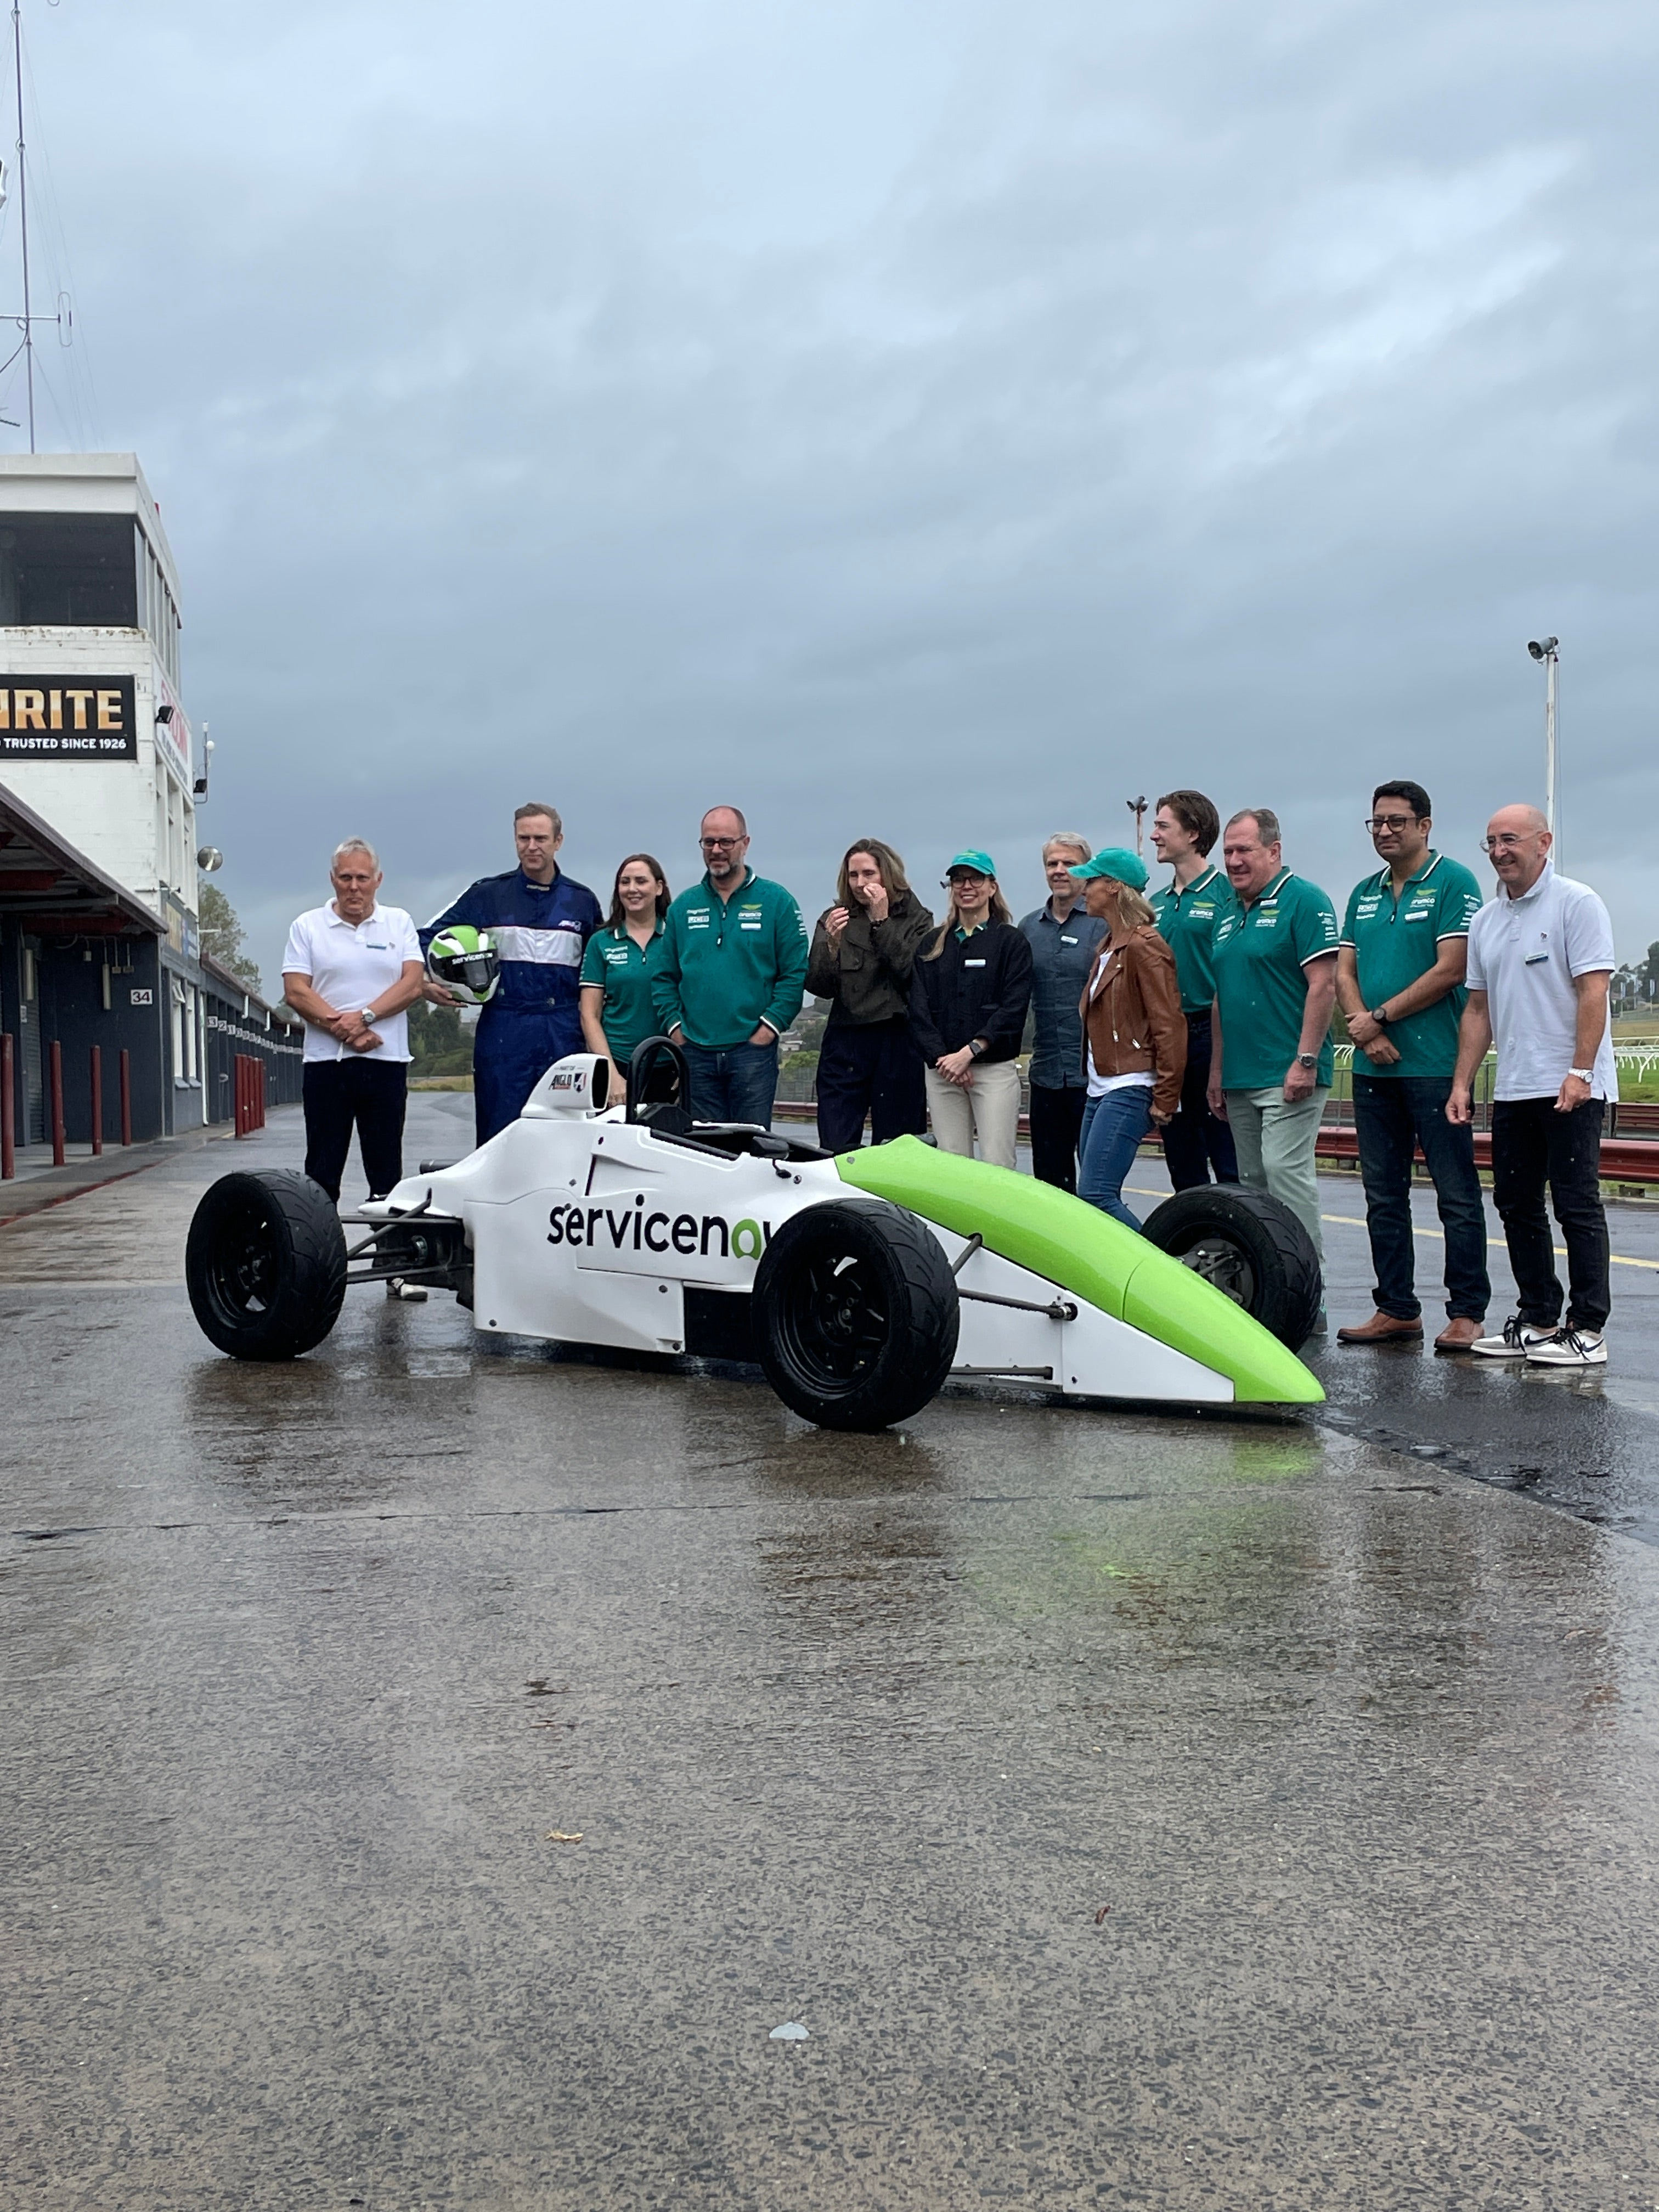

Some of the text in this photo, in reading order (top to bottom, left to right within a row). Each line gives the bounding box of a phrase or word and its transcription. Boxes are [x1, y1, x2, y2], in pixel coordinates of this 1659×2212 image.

[3, 737, 127, 749] TRUSTED SINCE 1926
[132, 991, 150, 1002] 34
